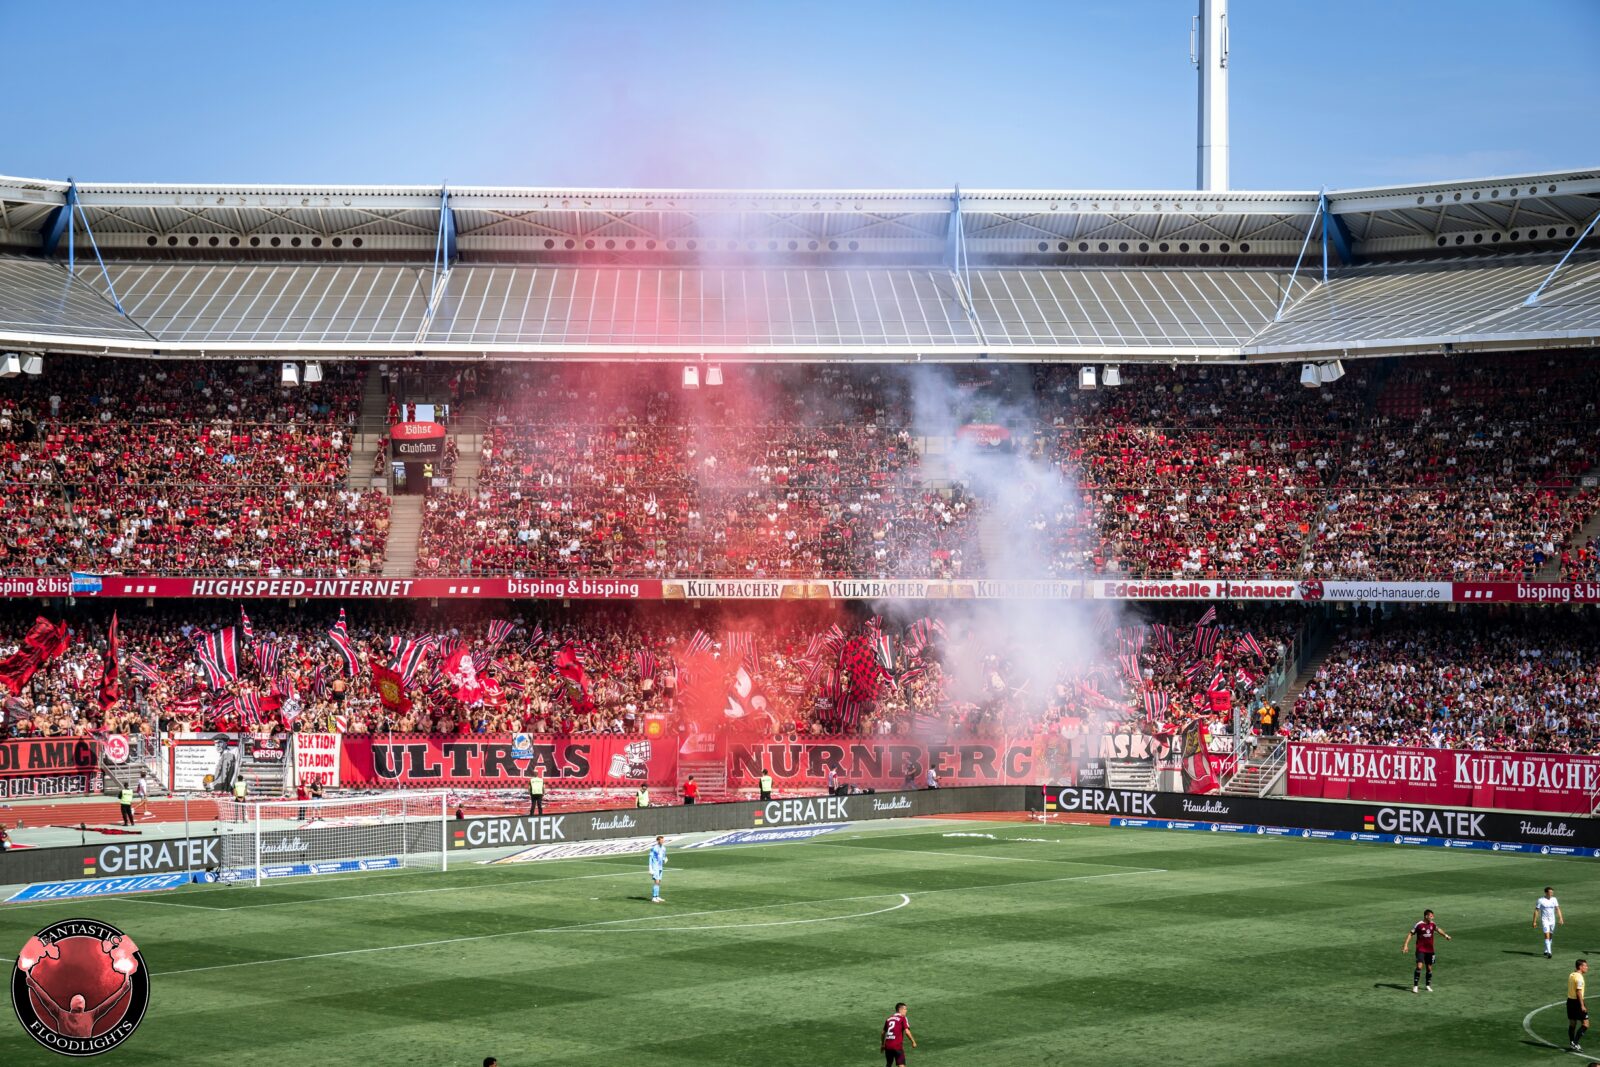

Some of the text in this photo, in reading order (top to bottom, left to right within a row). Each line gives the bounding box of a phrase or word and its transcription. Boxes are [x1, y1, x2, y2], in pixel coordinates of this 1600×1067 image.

[192, 580, 414, 596] HIGHSPEED-INTERNET
[507, 580, 639, 598] bisping & bisping
[687, 580, 779, 597] KULMBACHER
[832, 580, 924, 597] KULMBACHER
[977, 580, 1069, 597] KULMBCHER
[1216, 582, 1294, 598] Hanauer
[1330, 582, 1440, 599] www.gold-hanauer.de
[1517, 583, 1570, 601] bisping
[1574, 584, 1585, 598] &
[297, 734, 336, 750] SEKTION
[28, 741, 98, 769] AMICI
[298, 753, 335, 768] STADION
[371, 742, 591, 779] ULTRAS
[728, 735, 1034, 780] NÜRNBERG
[1289, 745, 1437, 782] KULMBACHER
[1453, 753, 1600, 791] KULMBACHE
[10, 775, 87, 796] ULTRAS!
[764, 795, 849, 824] GERATEK
[1059, 788, 1157, 815] GERATEK
[466, 815, 565, 845] GERATEK
[1377, 807, 1486, 837] GERATEK
[99, 838, 220, 873] GERATEK
[29, 873, 182, 899] HELMSAUER
[887, 1020, 896, 1036] 2
